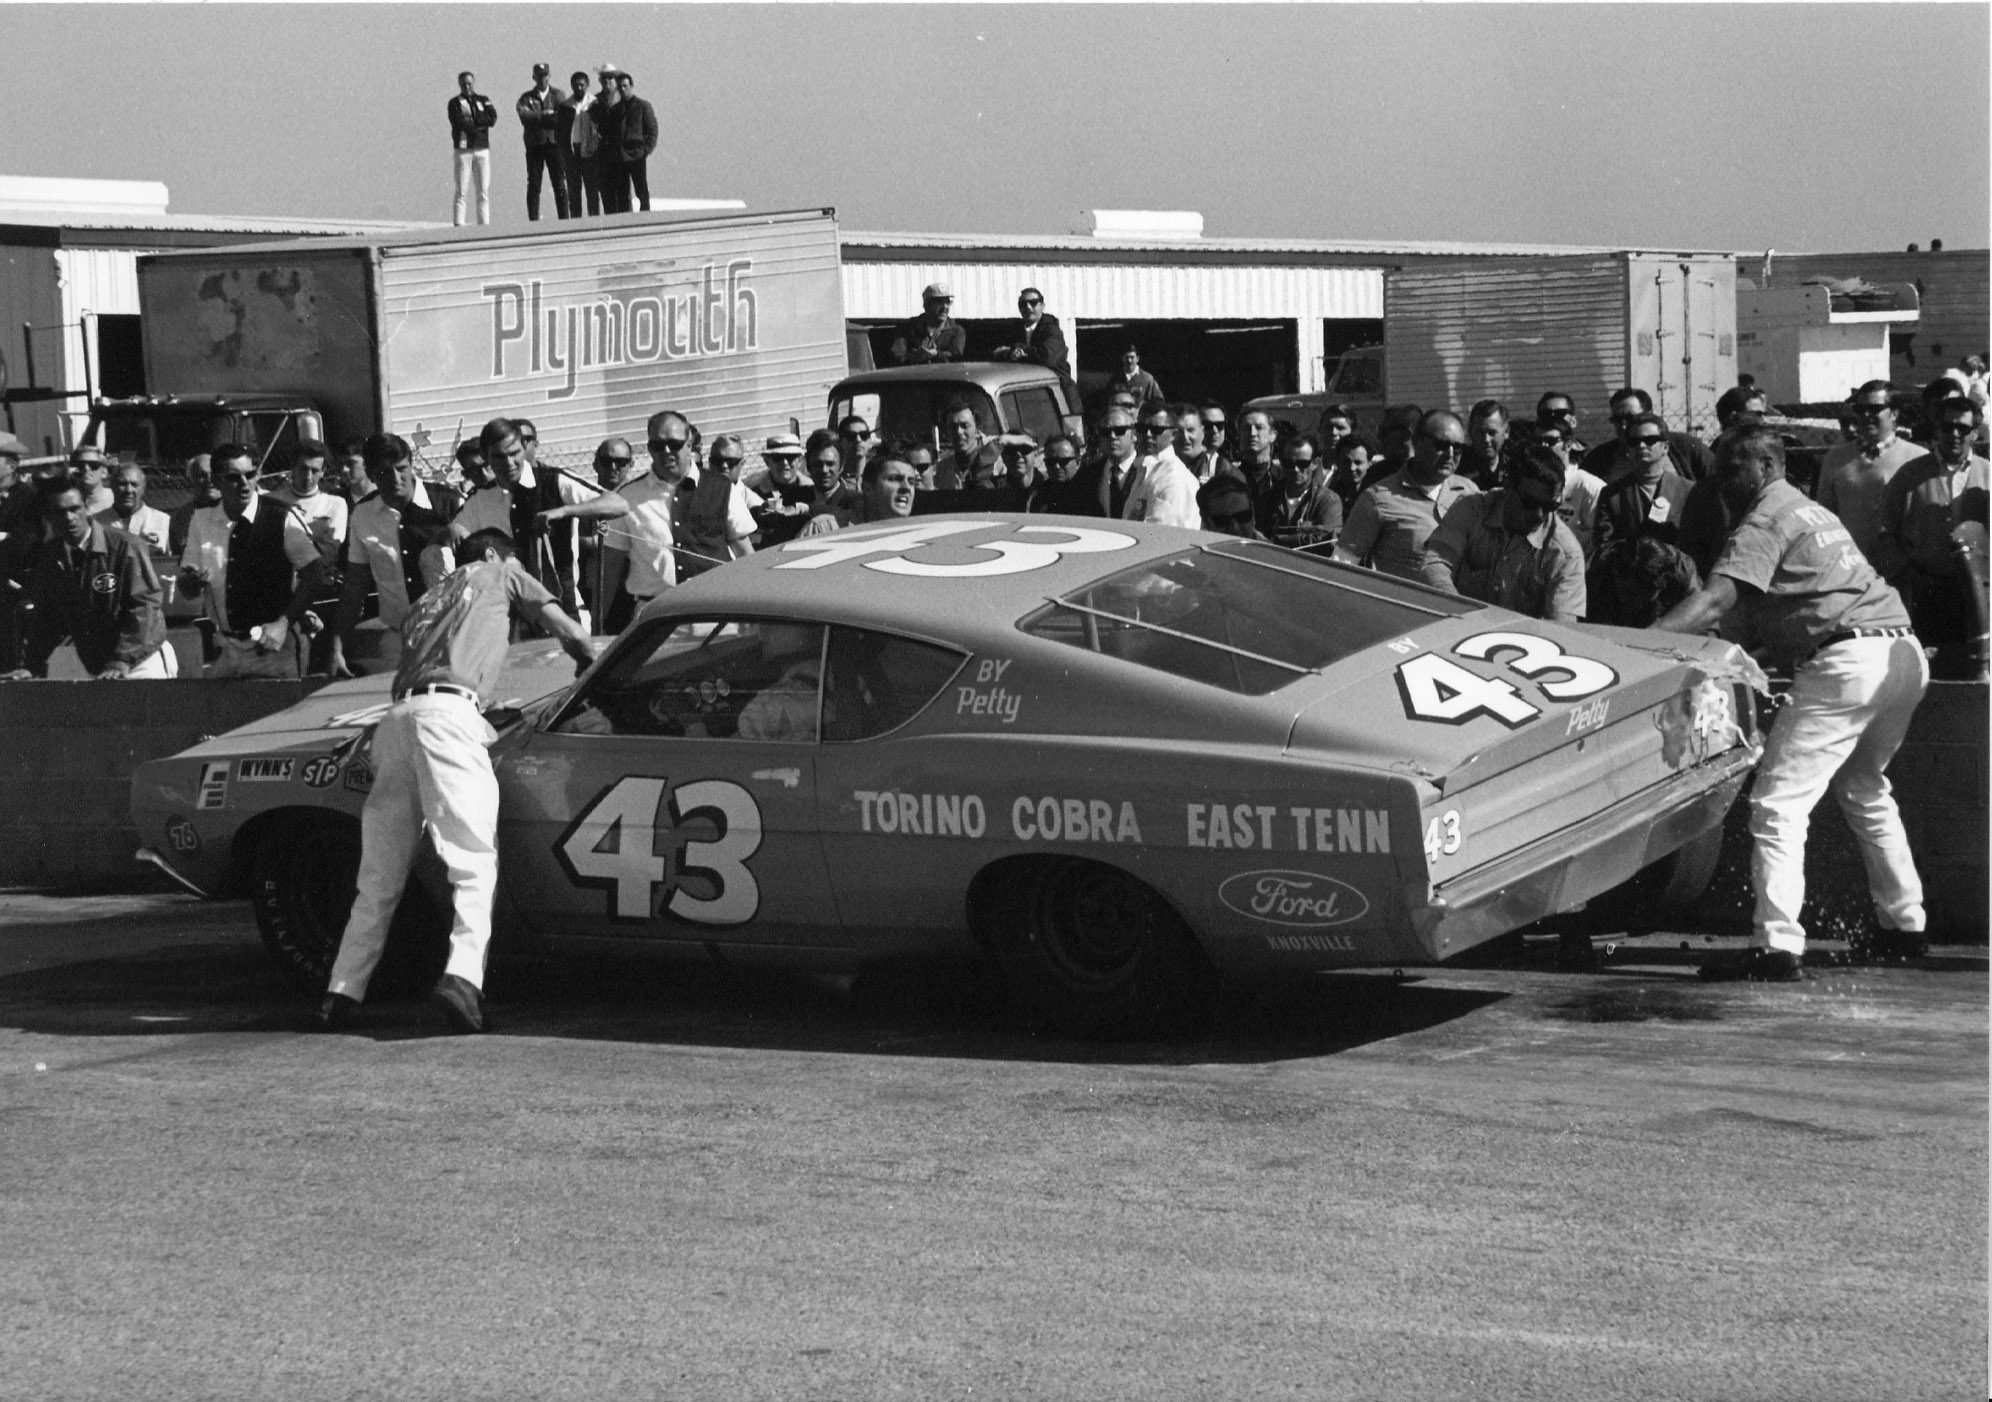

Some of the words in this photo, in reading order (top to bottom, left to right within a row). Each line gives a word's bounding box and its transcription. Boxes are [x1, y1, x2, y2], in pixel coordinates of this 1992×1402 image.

[481, 257, 758, 401] Plymouth
[769, 520, 1139, 577] 43
[1388, 636, 1420, 655] BY
[976, 658, 1012, 683] BY
[1396, 631, 1619, 728] 43
[957, 687, 1022, 723] Petty
[1565, 700, 1610, 736] Petty
[240, 759, 294, 777] WYNN'S
[303, 758, 337, 785] STP
[170, 822, 197, 850] 76
[854, 790, 986, 838] TORINO
[1012, 796, 1142, 842] COBRA
[1187, 803, 1276, 849] EAST
[1291, 807, 1390, 853] TENN
[1424, 809, 1462, 862] 43
[558, 775, 763, 927] 43
[1251, 876, 1339, 917] Ford
[1266, 934, 1356, 951] KNOXVILLE
